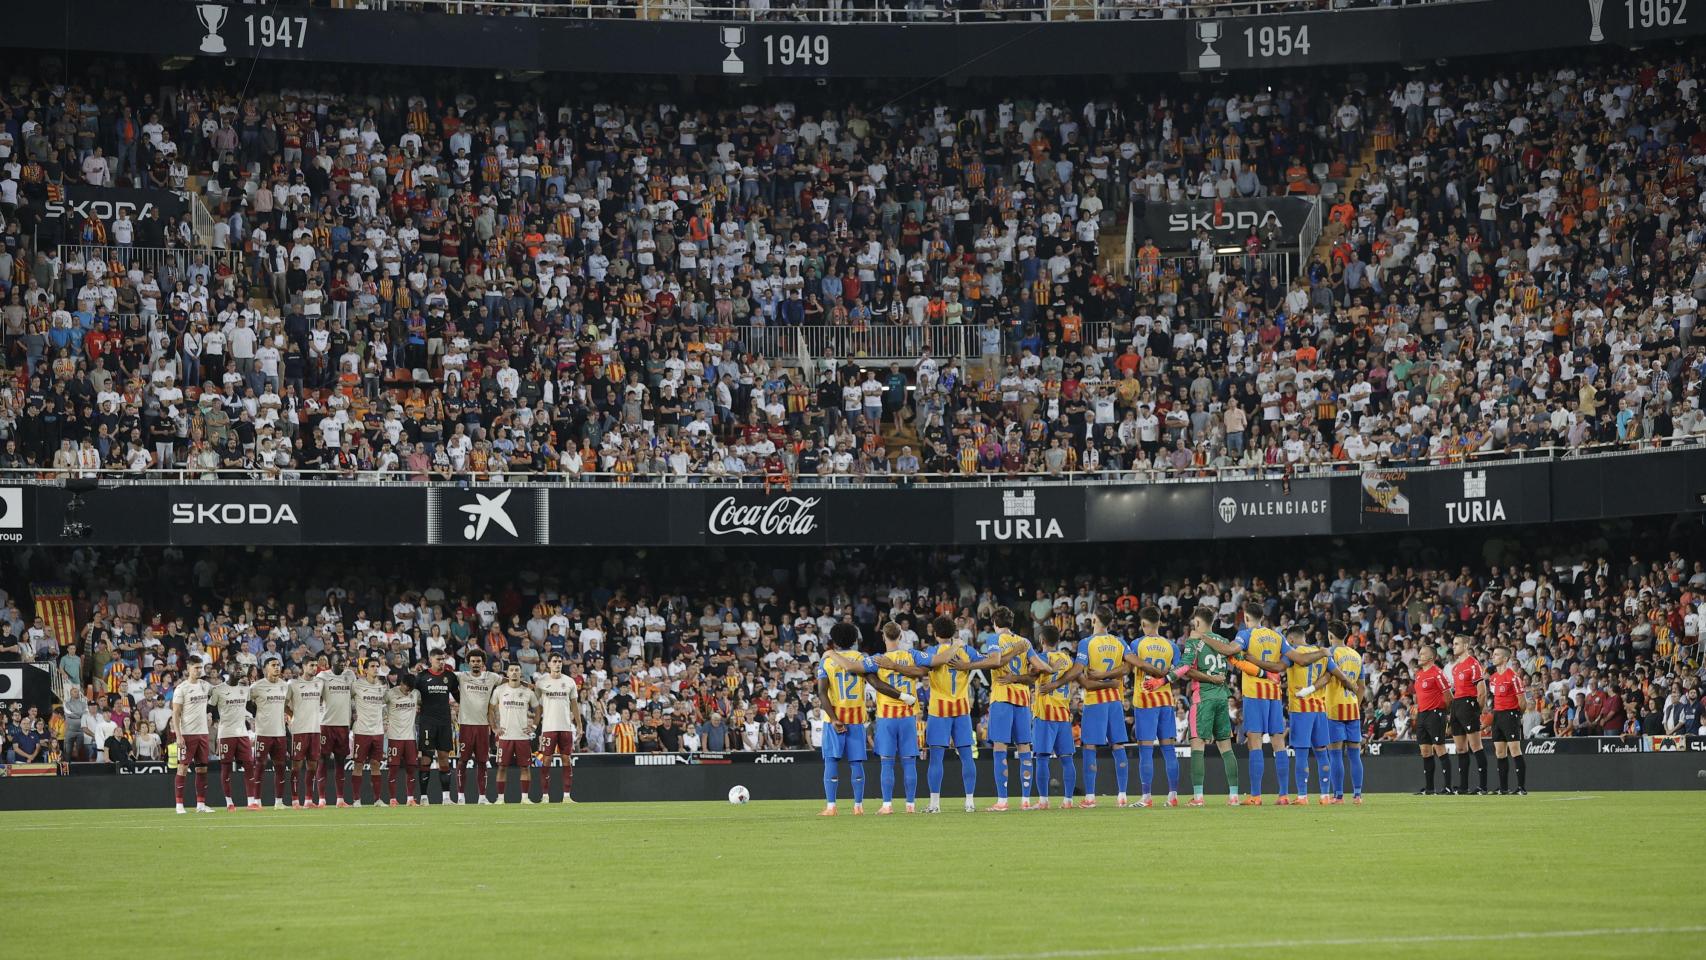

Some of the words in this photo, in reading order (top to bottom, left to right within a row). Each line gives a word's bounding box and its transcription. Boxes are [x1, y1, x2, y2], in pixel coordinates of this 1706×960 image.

[1625, 0, 1687, 29] 1962
[245, 15, 308, 49] 1947
[1244, 25, 1311, 58] 1954
[764, 34, 829, 66] 1949
[709, 496, 822, 536] Coca-Cola
[1445, 499, 1507, 524] TURIA
[976, 518, 1064, 541] TURIA
[835, 671, 859, 700] 12
